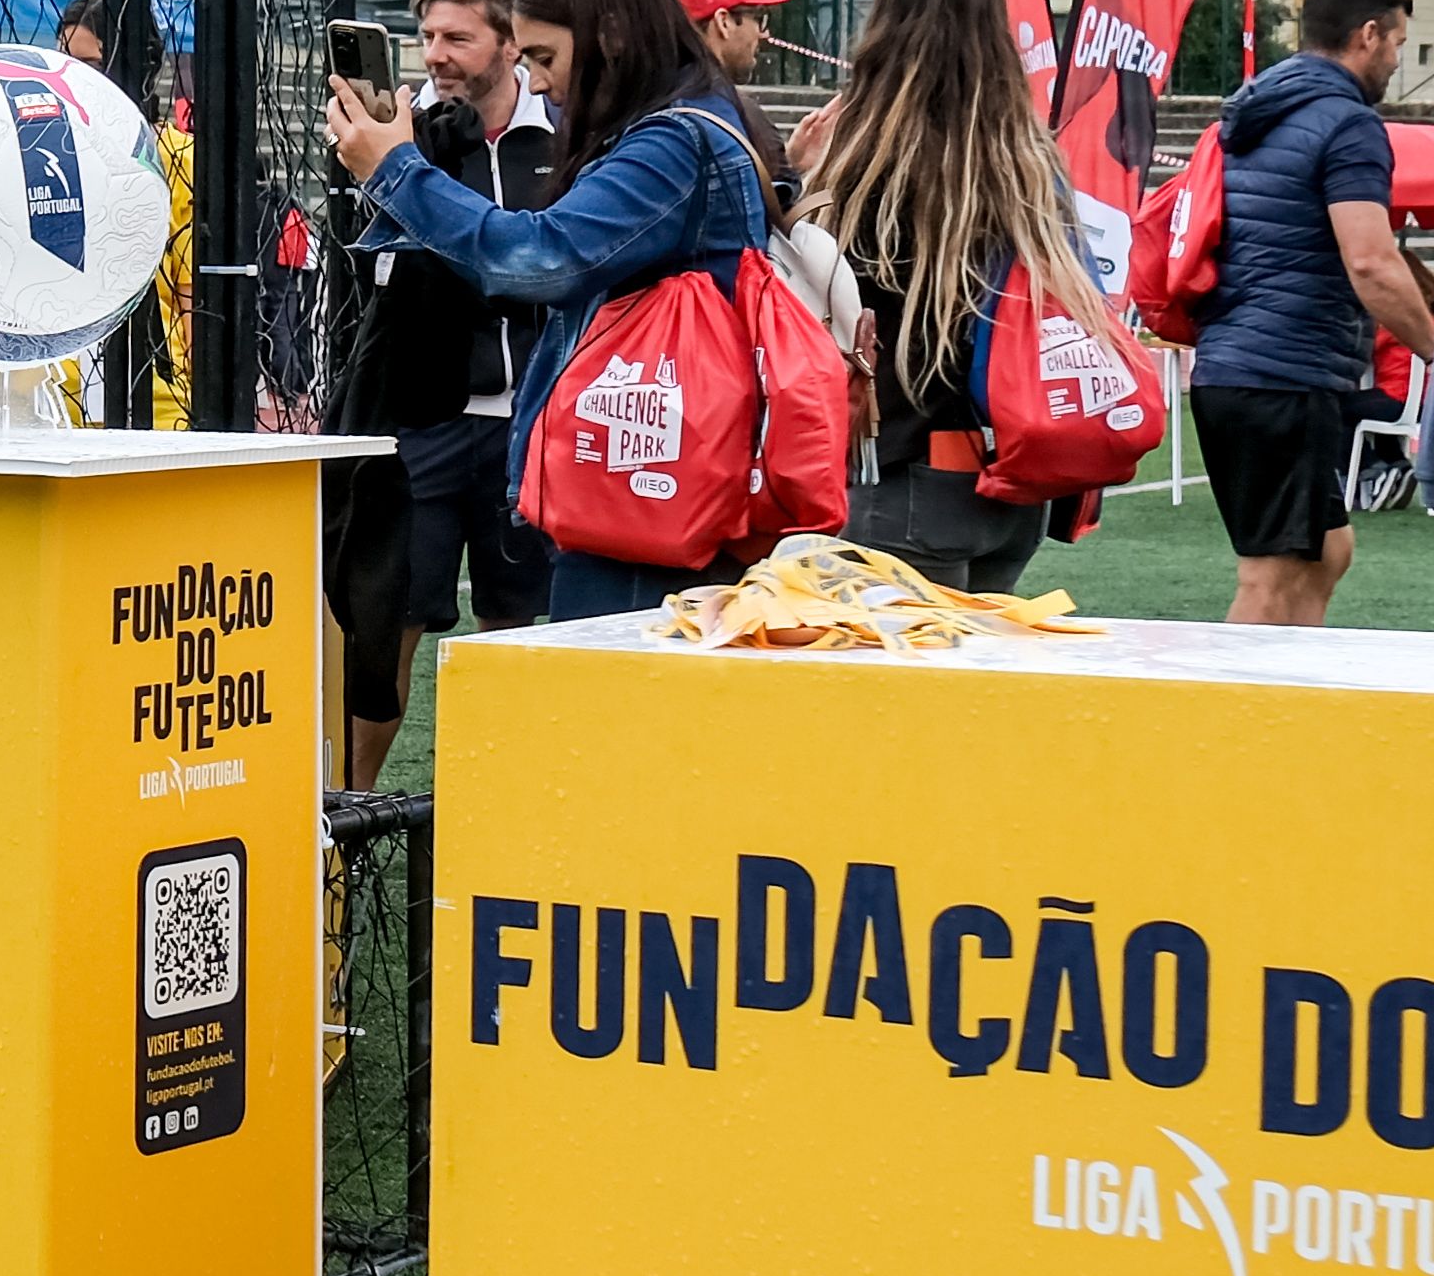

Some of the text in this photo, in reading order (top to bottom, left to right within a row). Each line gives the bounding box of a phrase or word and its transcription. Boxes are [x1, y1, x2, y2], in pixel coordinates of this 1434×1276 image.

[28, 185, 52, 200] LIGA
[30, 198, 82, 216] PORTUGAL
[583, 389, 669, 430] CHALLENGE
[620, 429, 665, 461] PARK
[635, 477, 670, 493] MEO
[112, 562, 273, 646] FUNDAÇÃO
[176, 631, 215, 685] DO
[133, 670, 272, 753] FUTEBOL
[139, 758, 247, 800] LIGA PORTUGAL
[470, 852, 1213, 1089] FUNDAÇÃO
[146, 1021, 224, 1058] VISITE-NOS EM:
[146, 1049, 235, 1083] fundacaodofutebol.
[146, 1076, 214, 1106] ligaportugal.pt
[1033, 1155, 1164, 1244] LIGA
